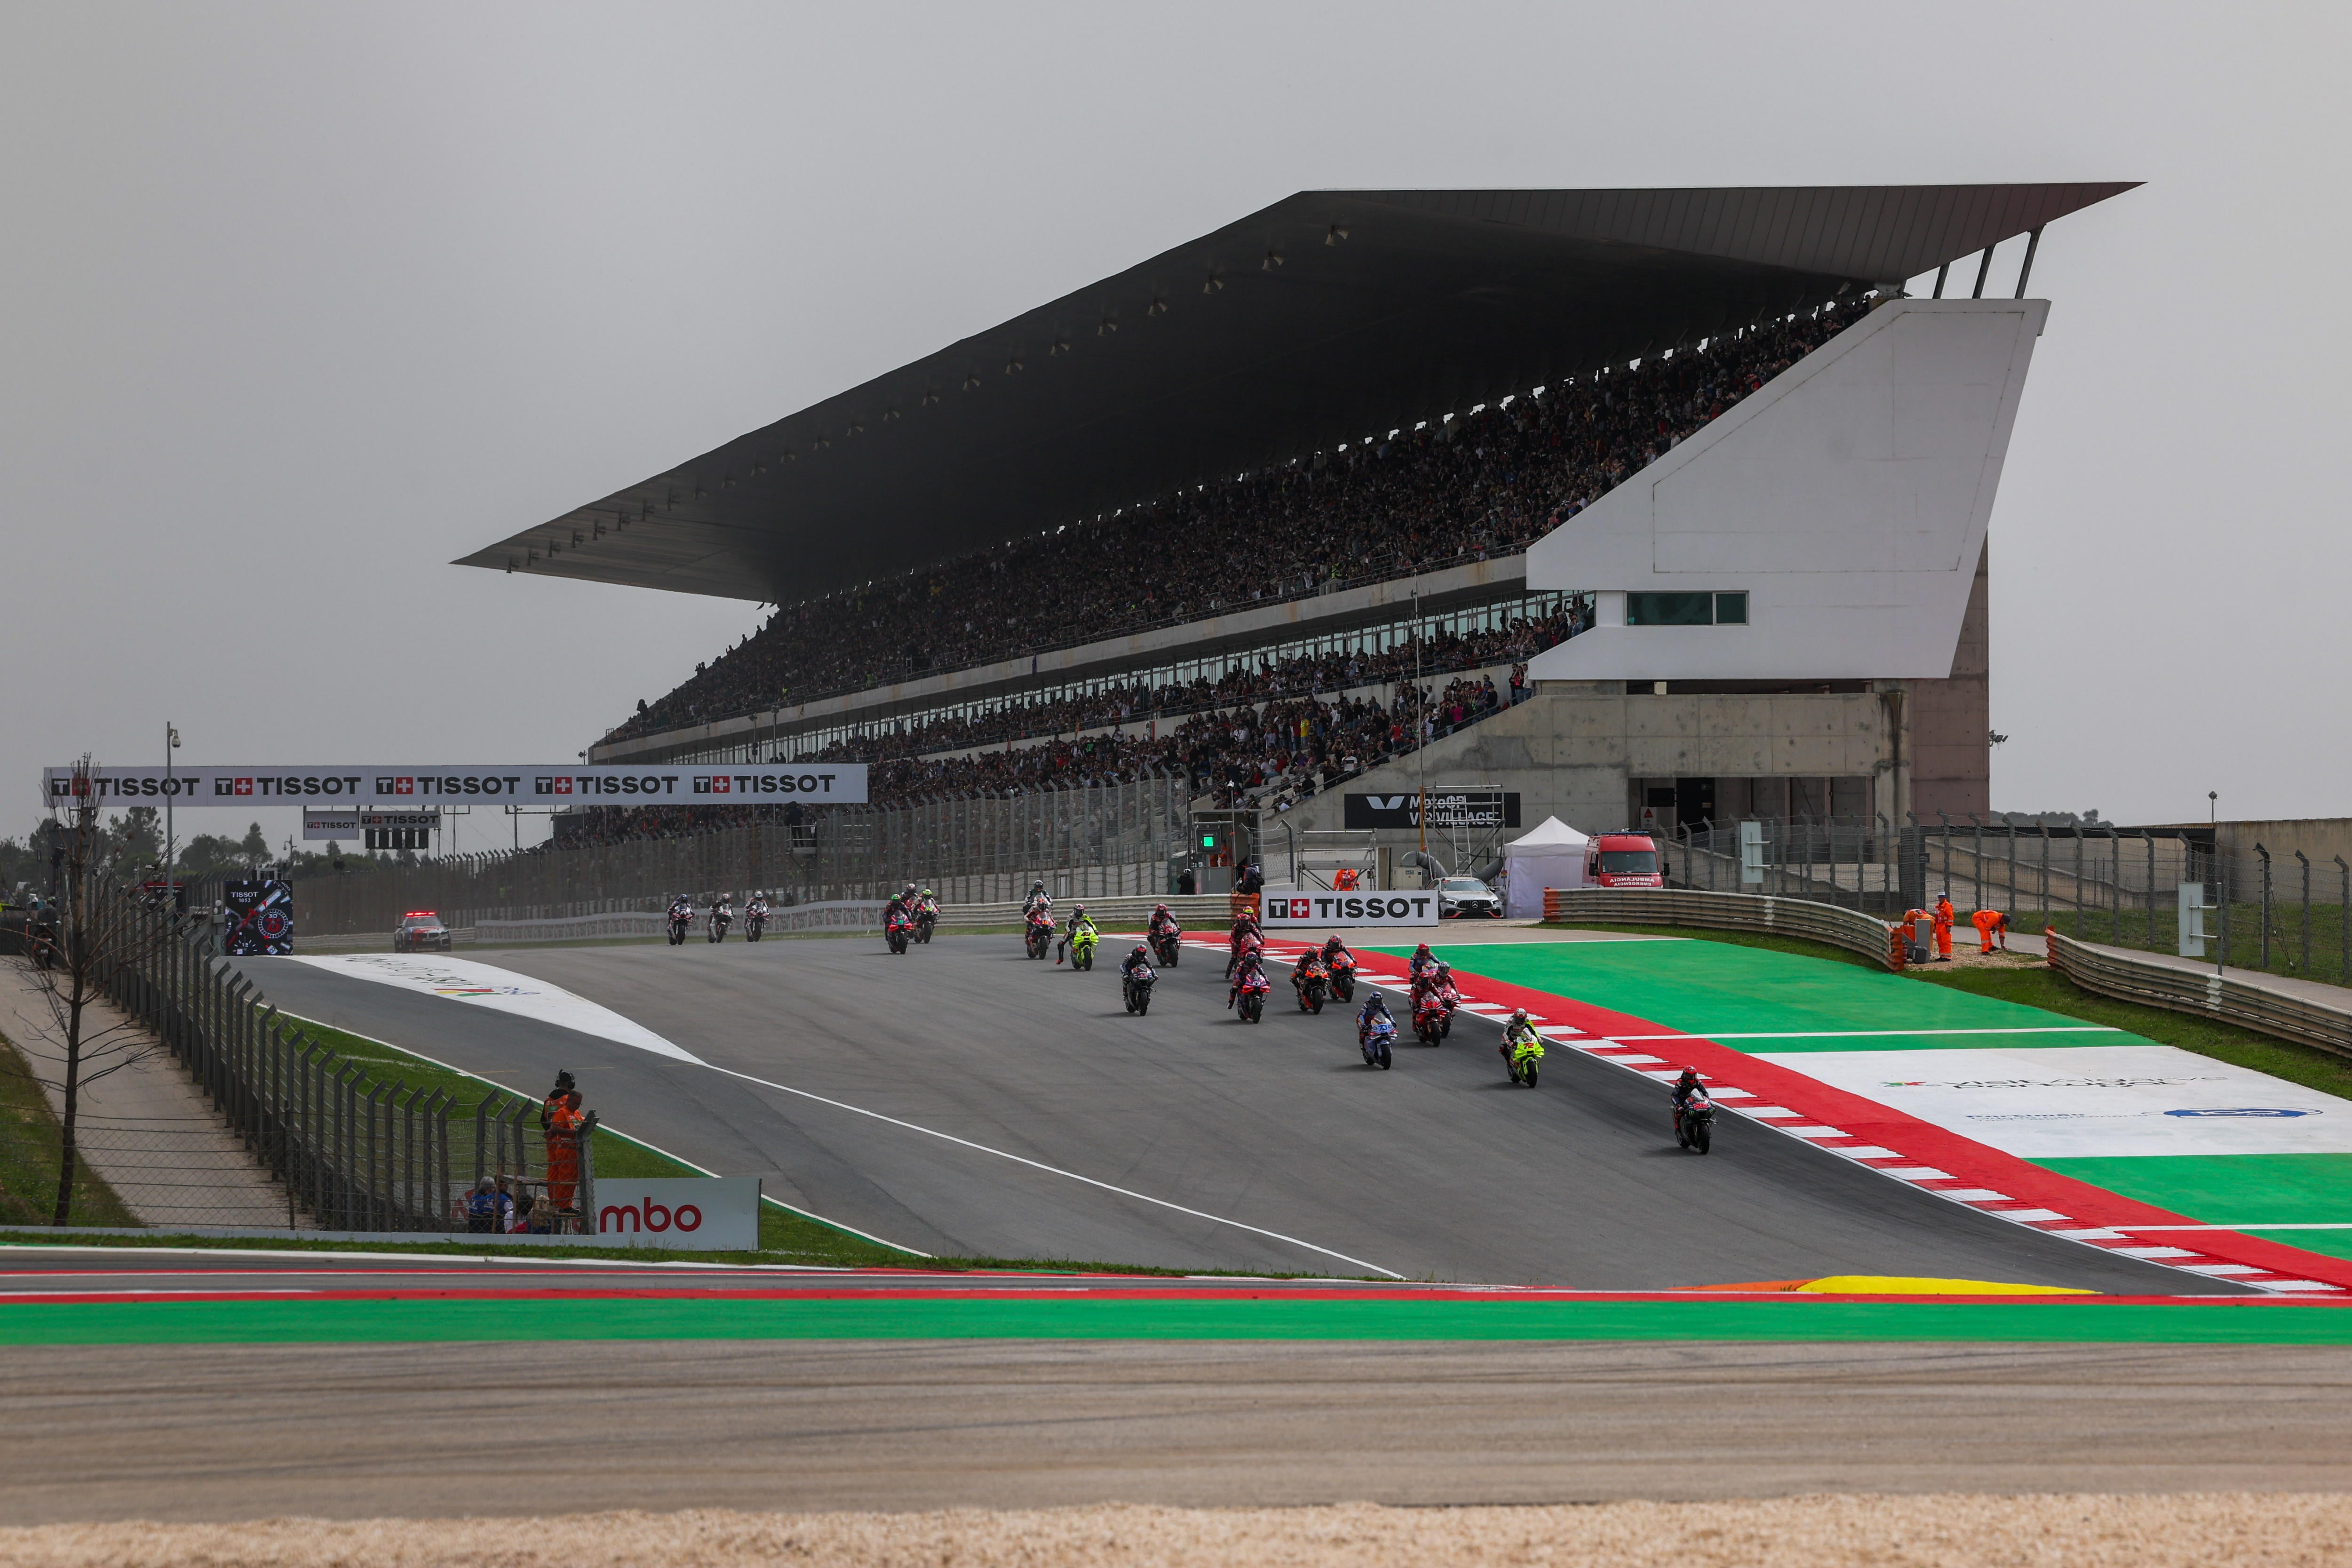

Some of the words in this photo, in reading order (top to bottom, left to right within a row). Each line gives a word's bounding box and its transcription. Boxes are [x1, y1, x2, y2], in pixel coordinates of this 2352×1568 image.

[94, 778, 200, 796] TISSOT
[256, 777, 361, 795] TISSOT
[417, 776, 521, 795] TISSOT
[576, 776, 679, 794] TISSOT
[734, 774, 836, 793] TISSOT
[383, 815, 438, 824] TISSOT
[1314, 898, 1430, 918] TISSOT
